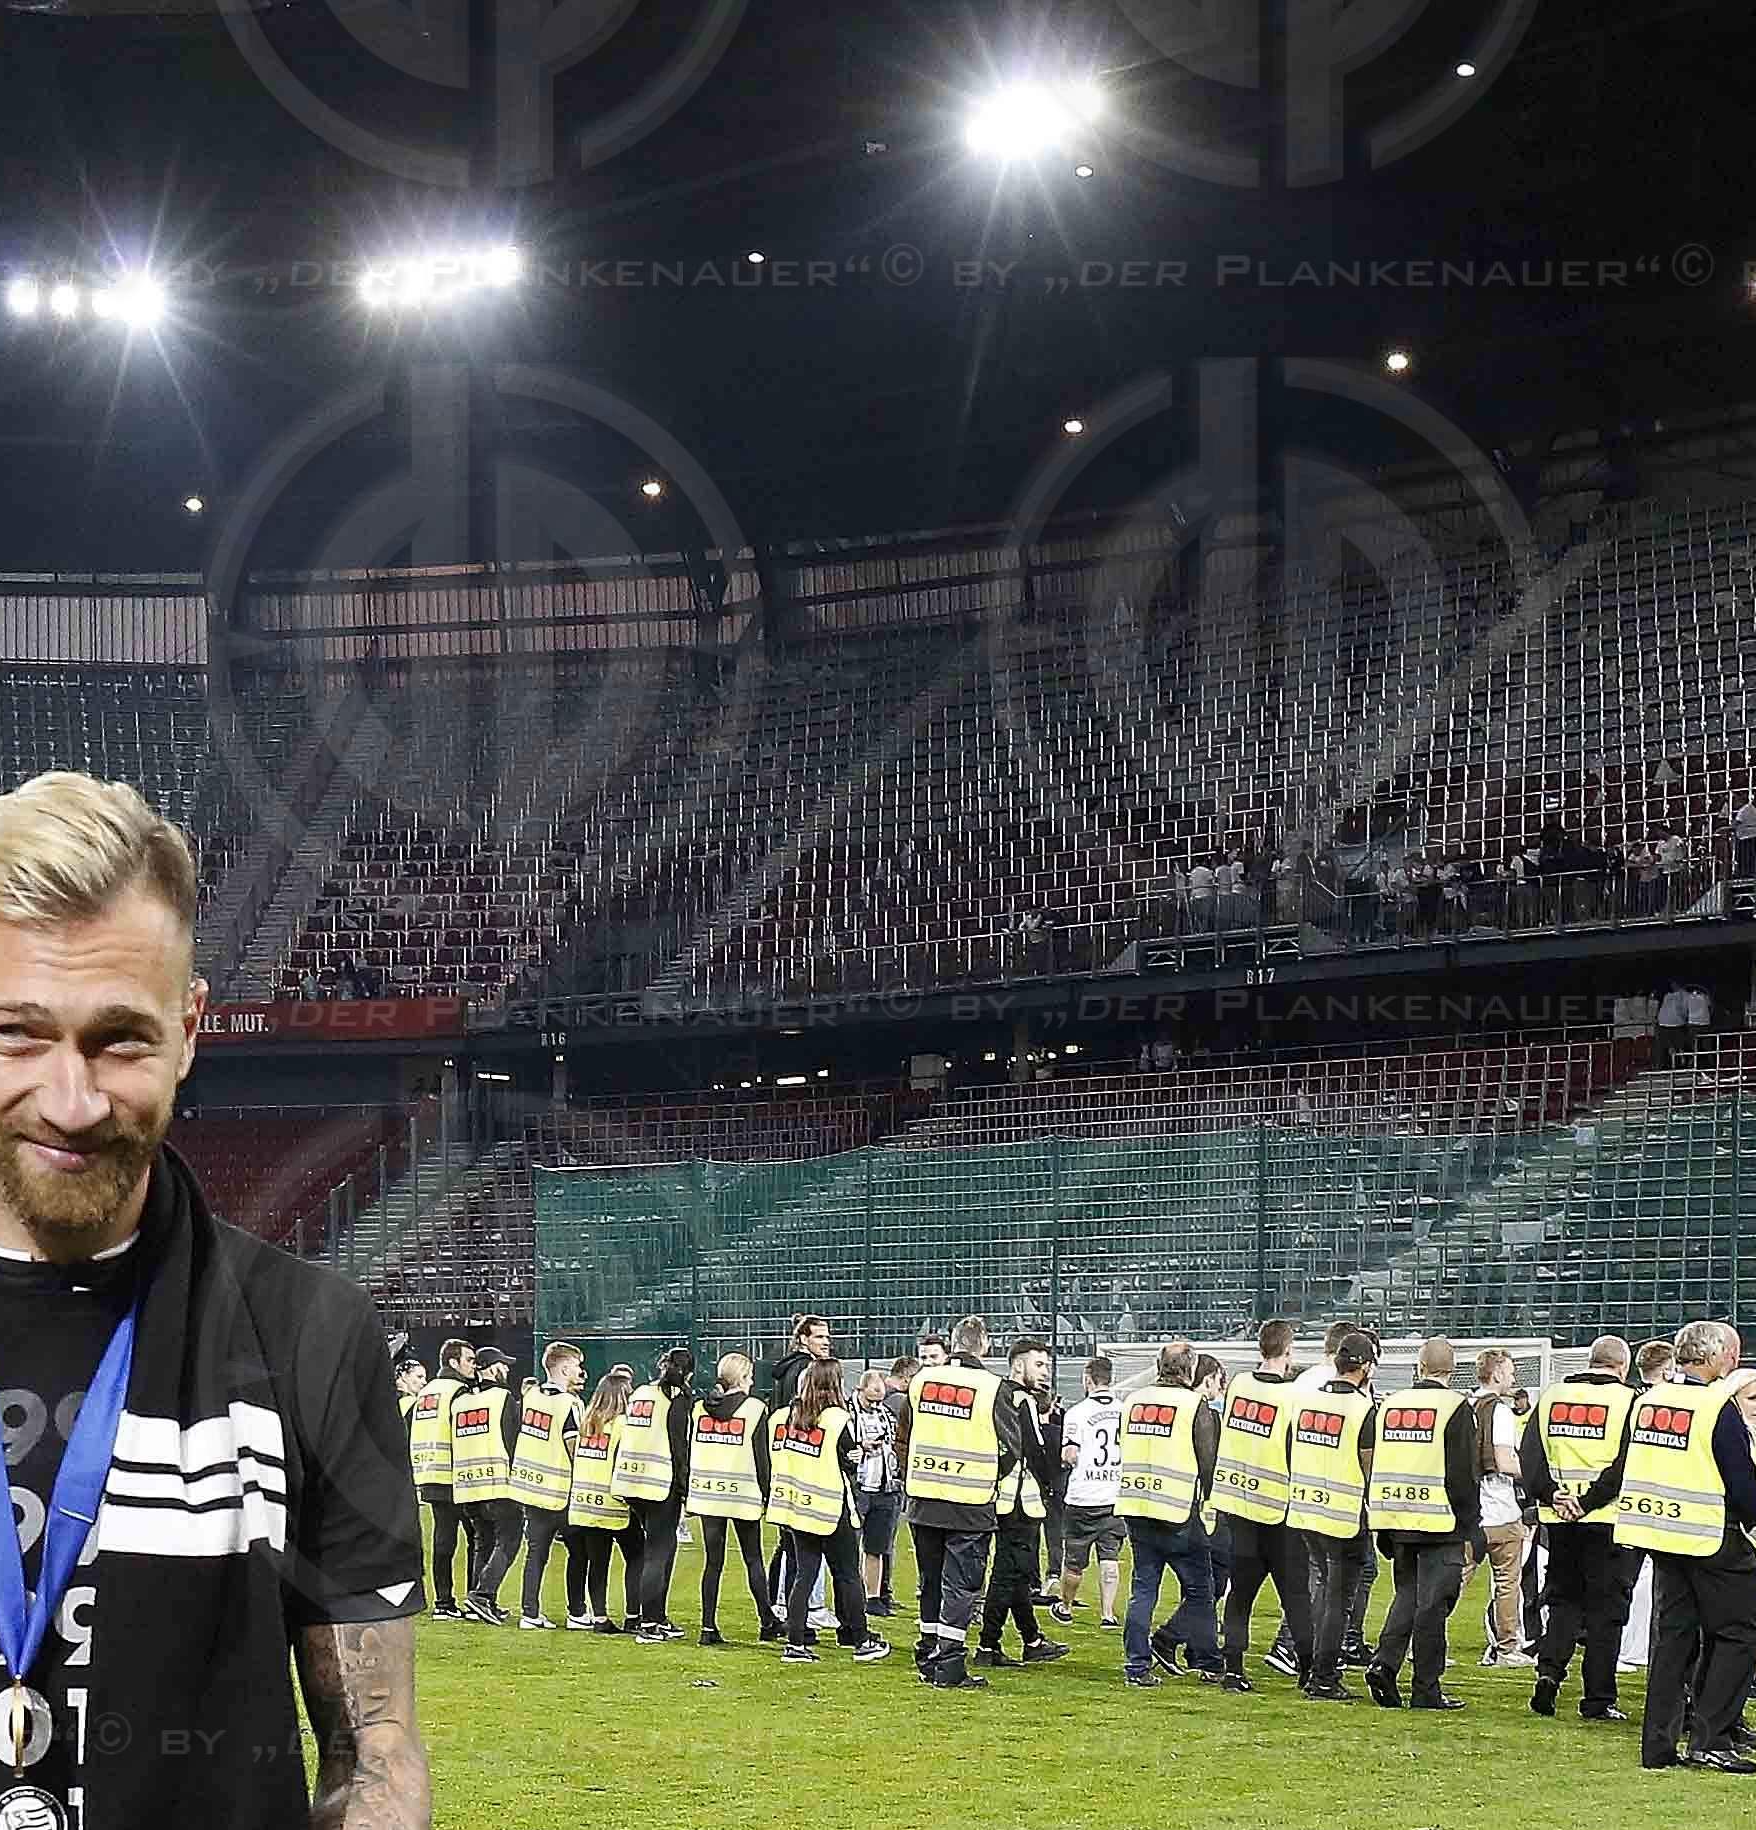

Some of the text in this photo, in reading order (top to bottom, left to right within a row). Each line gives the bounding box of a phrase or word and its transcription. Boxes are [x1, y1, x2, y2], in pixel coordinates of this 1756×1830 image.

[231, 1013, 269, 1033] MUT.
[919, 1401, 971, 1419] SECURITAS
[1548, 1425, 1604, 1438] SECURITAS
[1634, 1429, 1687, 1448] SECURITAS
[913, 1456, 966, 1474] 5947
[457, 1466, 495, 1482] 5638
[690, 1477, 739, 1493] 5455
[1381, 1486, 1431, 1501] 5488
